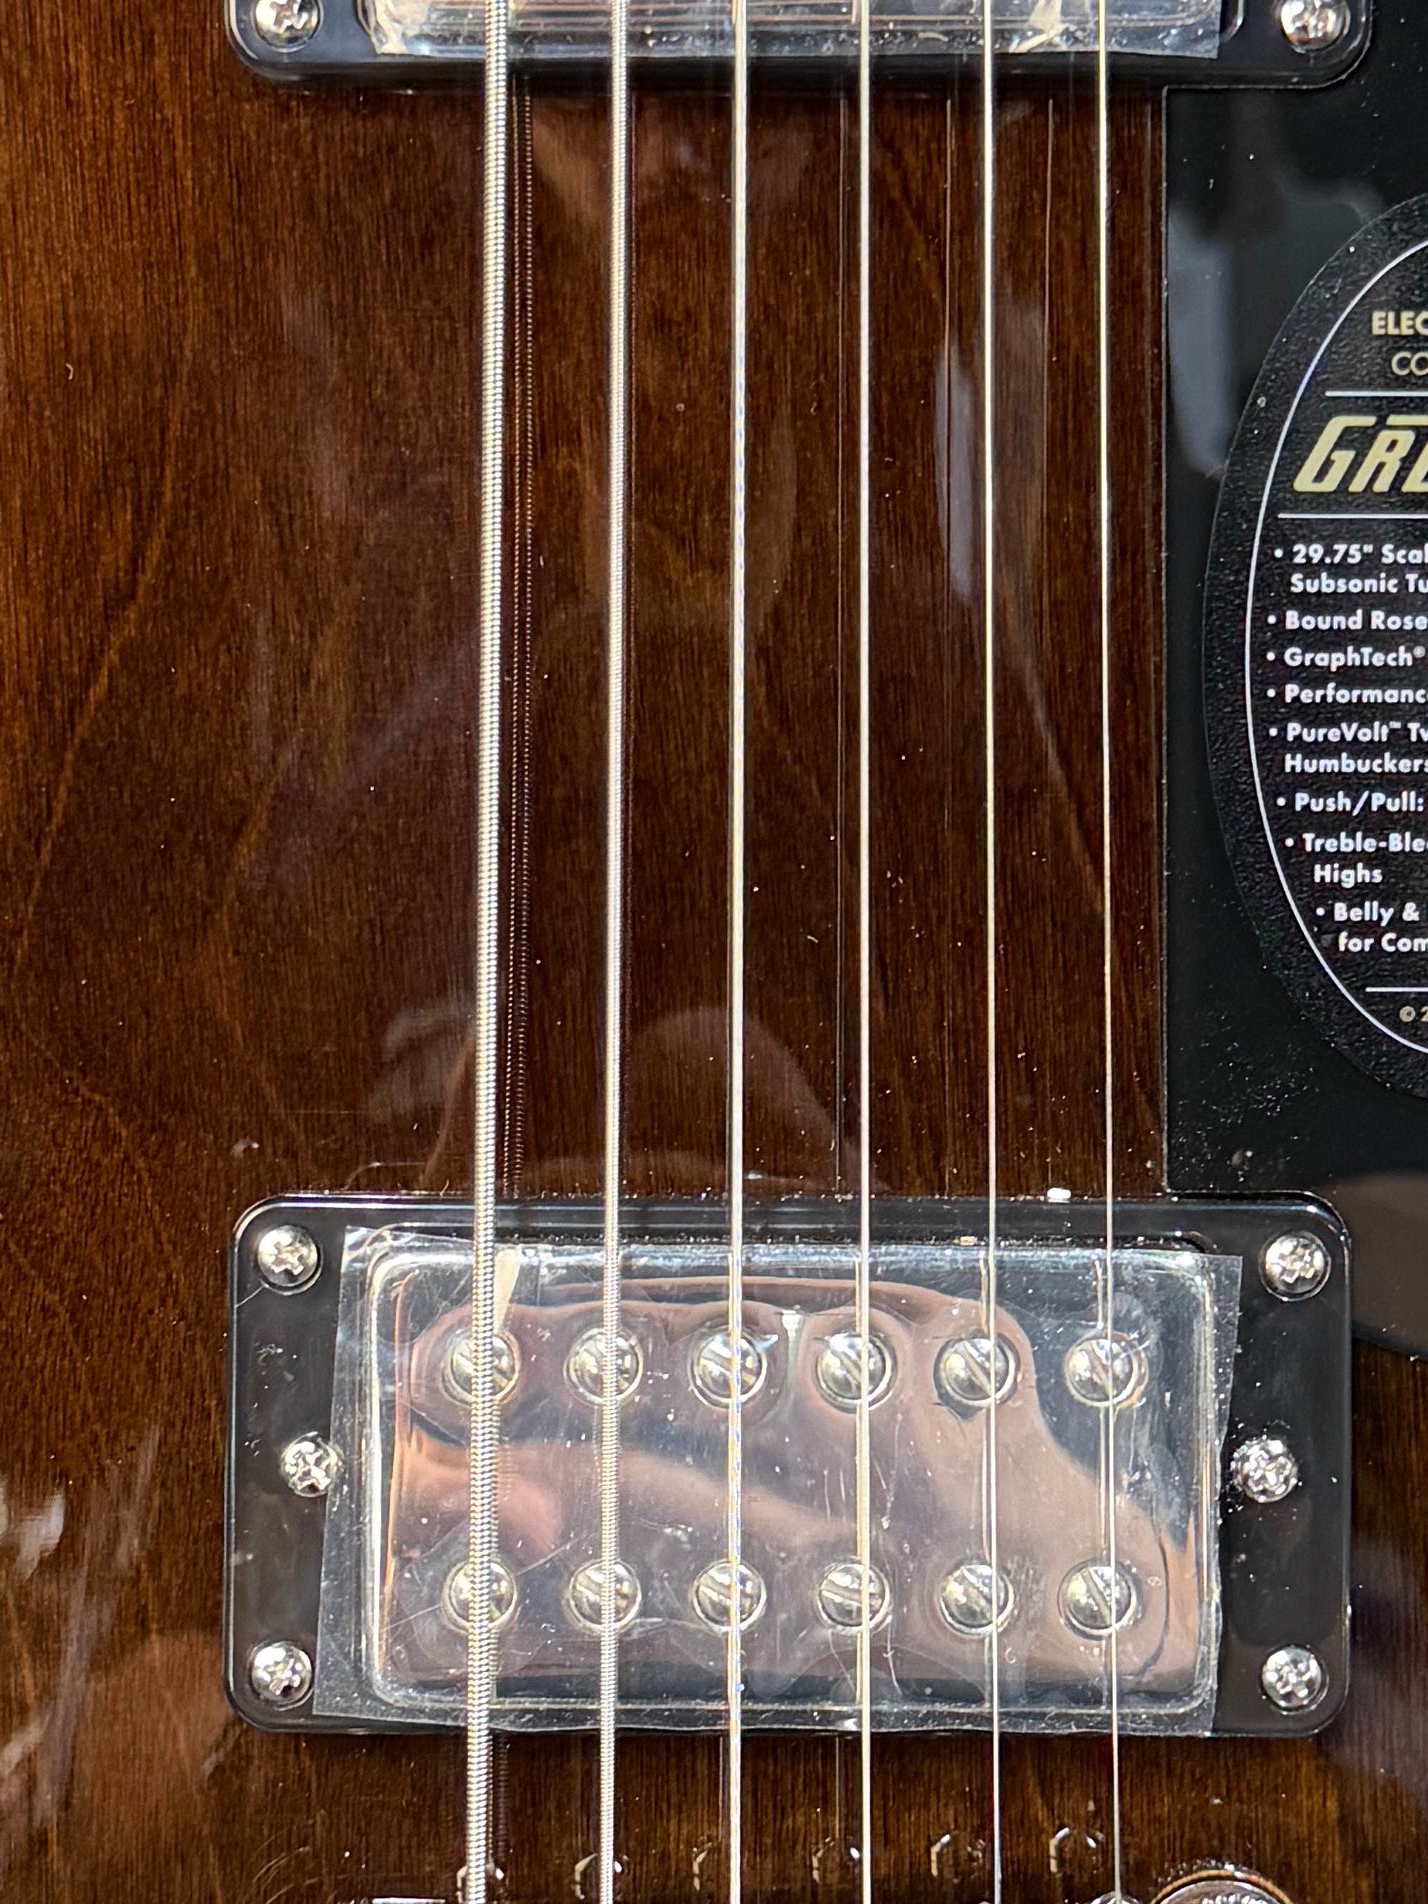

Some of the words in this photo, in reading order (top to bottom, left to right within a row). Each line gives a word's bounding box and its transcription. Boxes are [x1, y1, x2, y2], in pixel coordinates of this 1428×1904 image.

[1290, 573, 1399, 594] Subsonic
[1285, 609, 1363, 631] Bound
[1294, 791, 1424, 817] Push/Pull:
[1313, 863, 1383, 888] Highs
[1333, 901, 1394, 926] Belly
[1402, 902, 1420, 922] &
[1338, 932, 1375, 952] for
